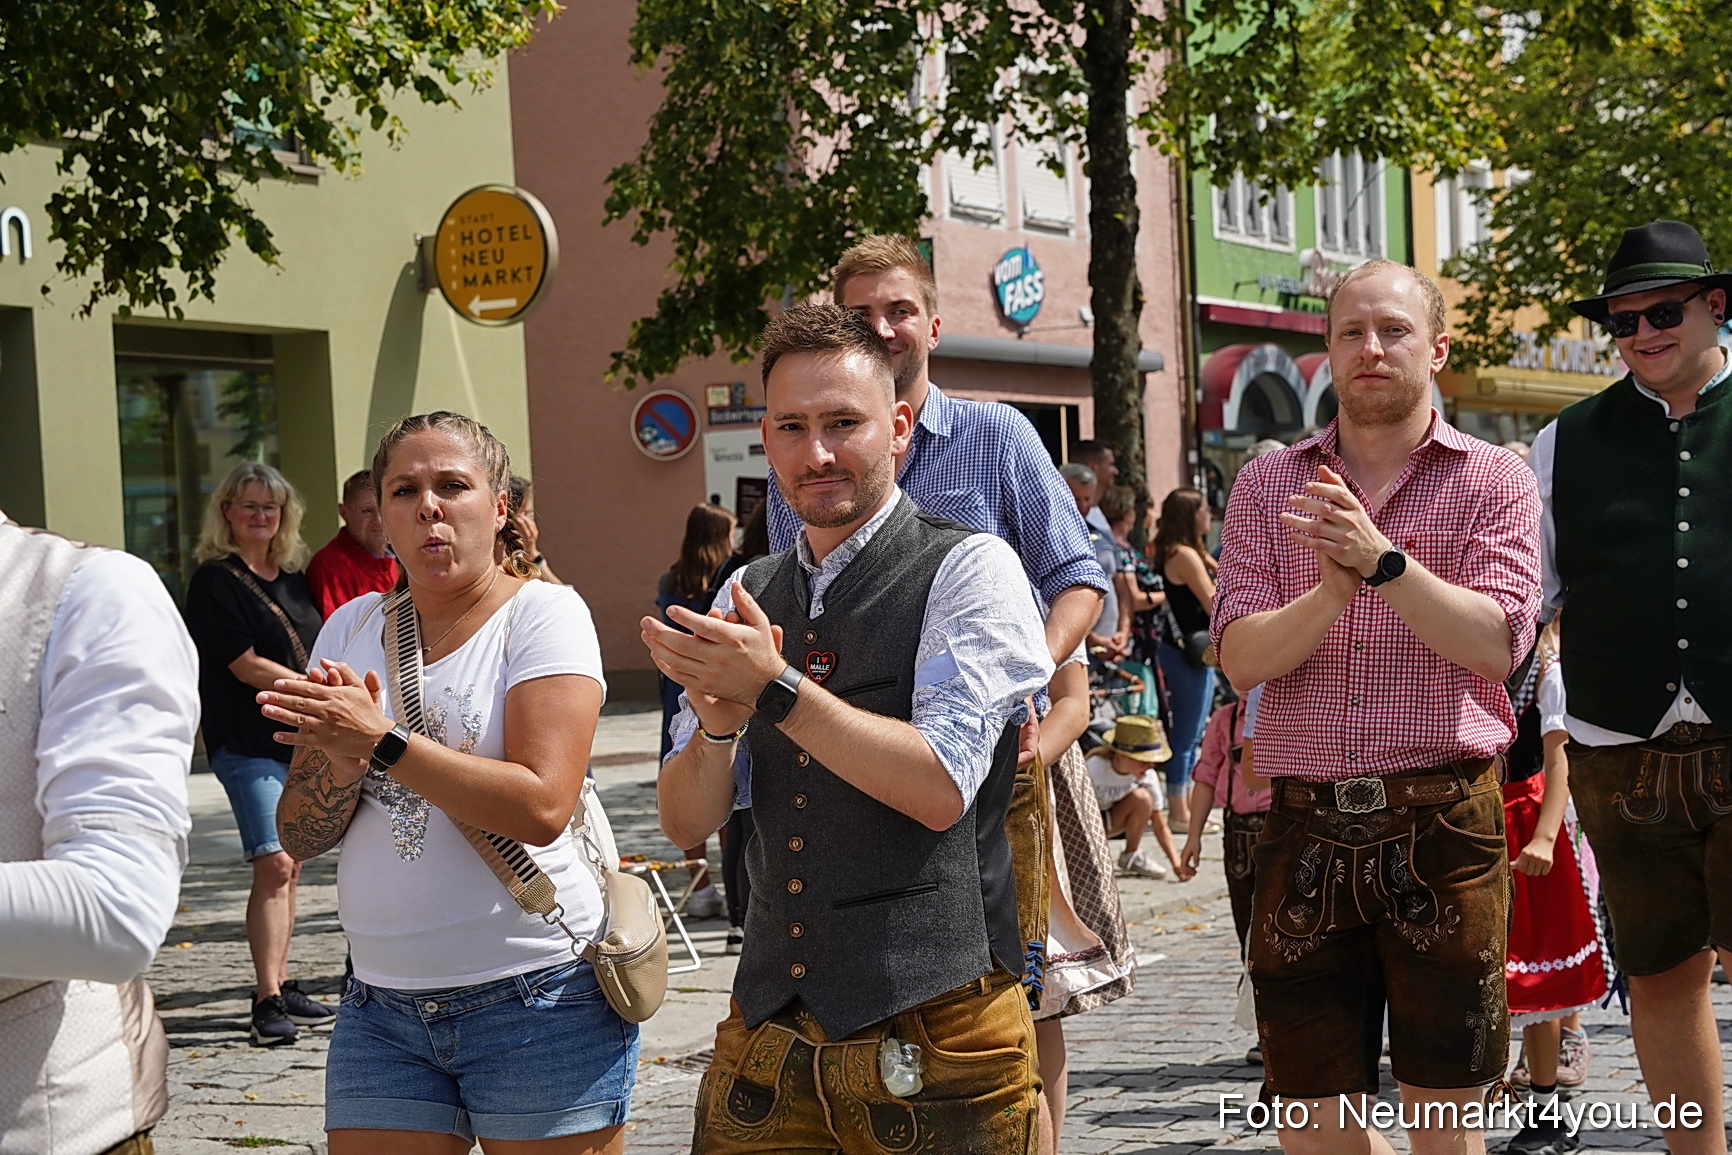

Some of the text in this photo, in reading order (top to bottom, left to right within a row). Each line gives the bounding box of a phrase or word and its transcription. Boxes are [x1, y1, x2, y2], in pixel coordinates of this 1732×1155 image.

[459, 212, 495, 224] STADT
[461, 224, 533, 246] HOTEL
[462, 248, 505, 268] NEU
[463, 265, 533, 287] MARKT
[1004, 268, 1046, 317] FASS
[809, 663, 831, 671] MALLE
[816, 656, 820, 664] I
